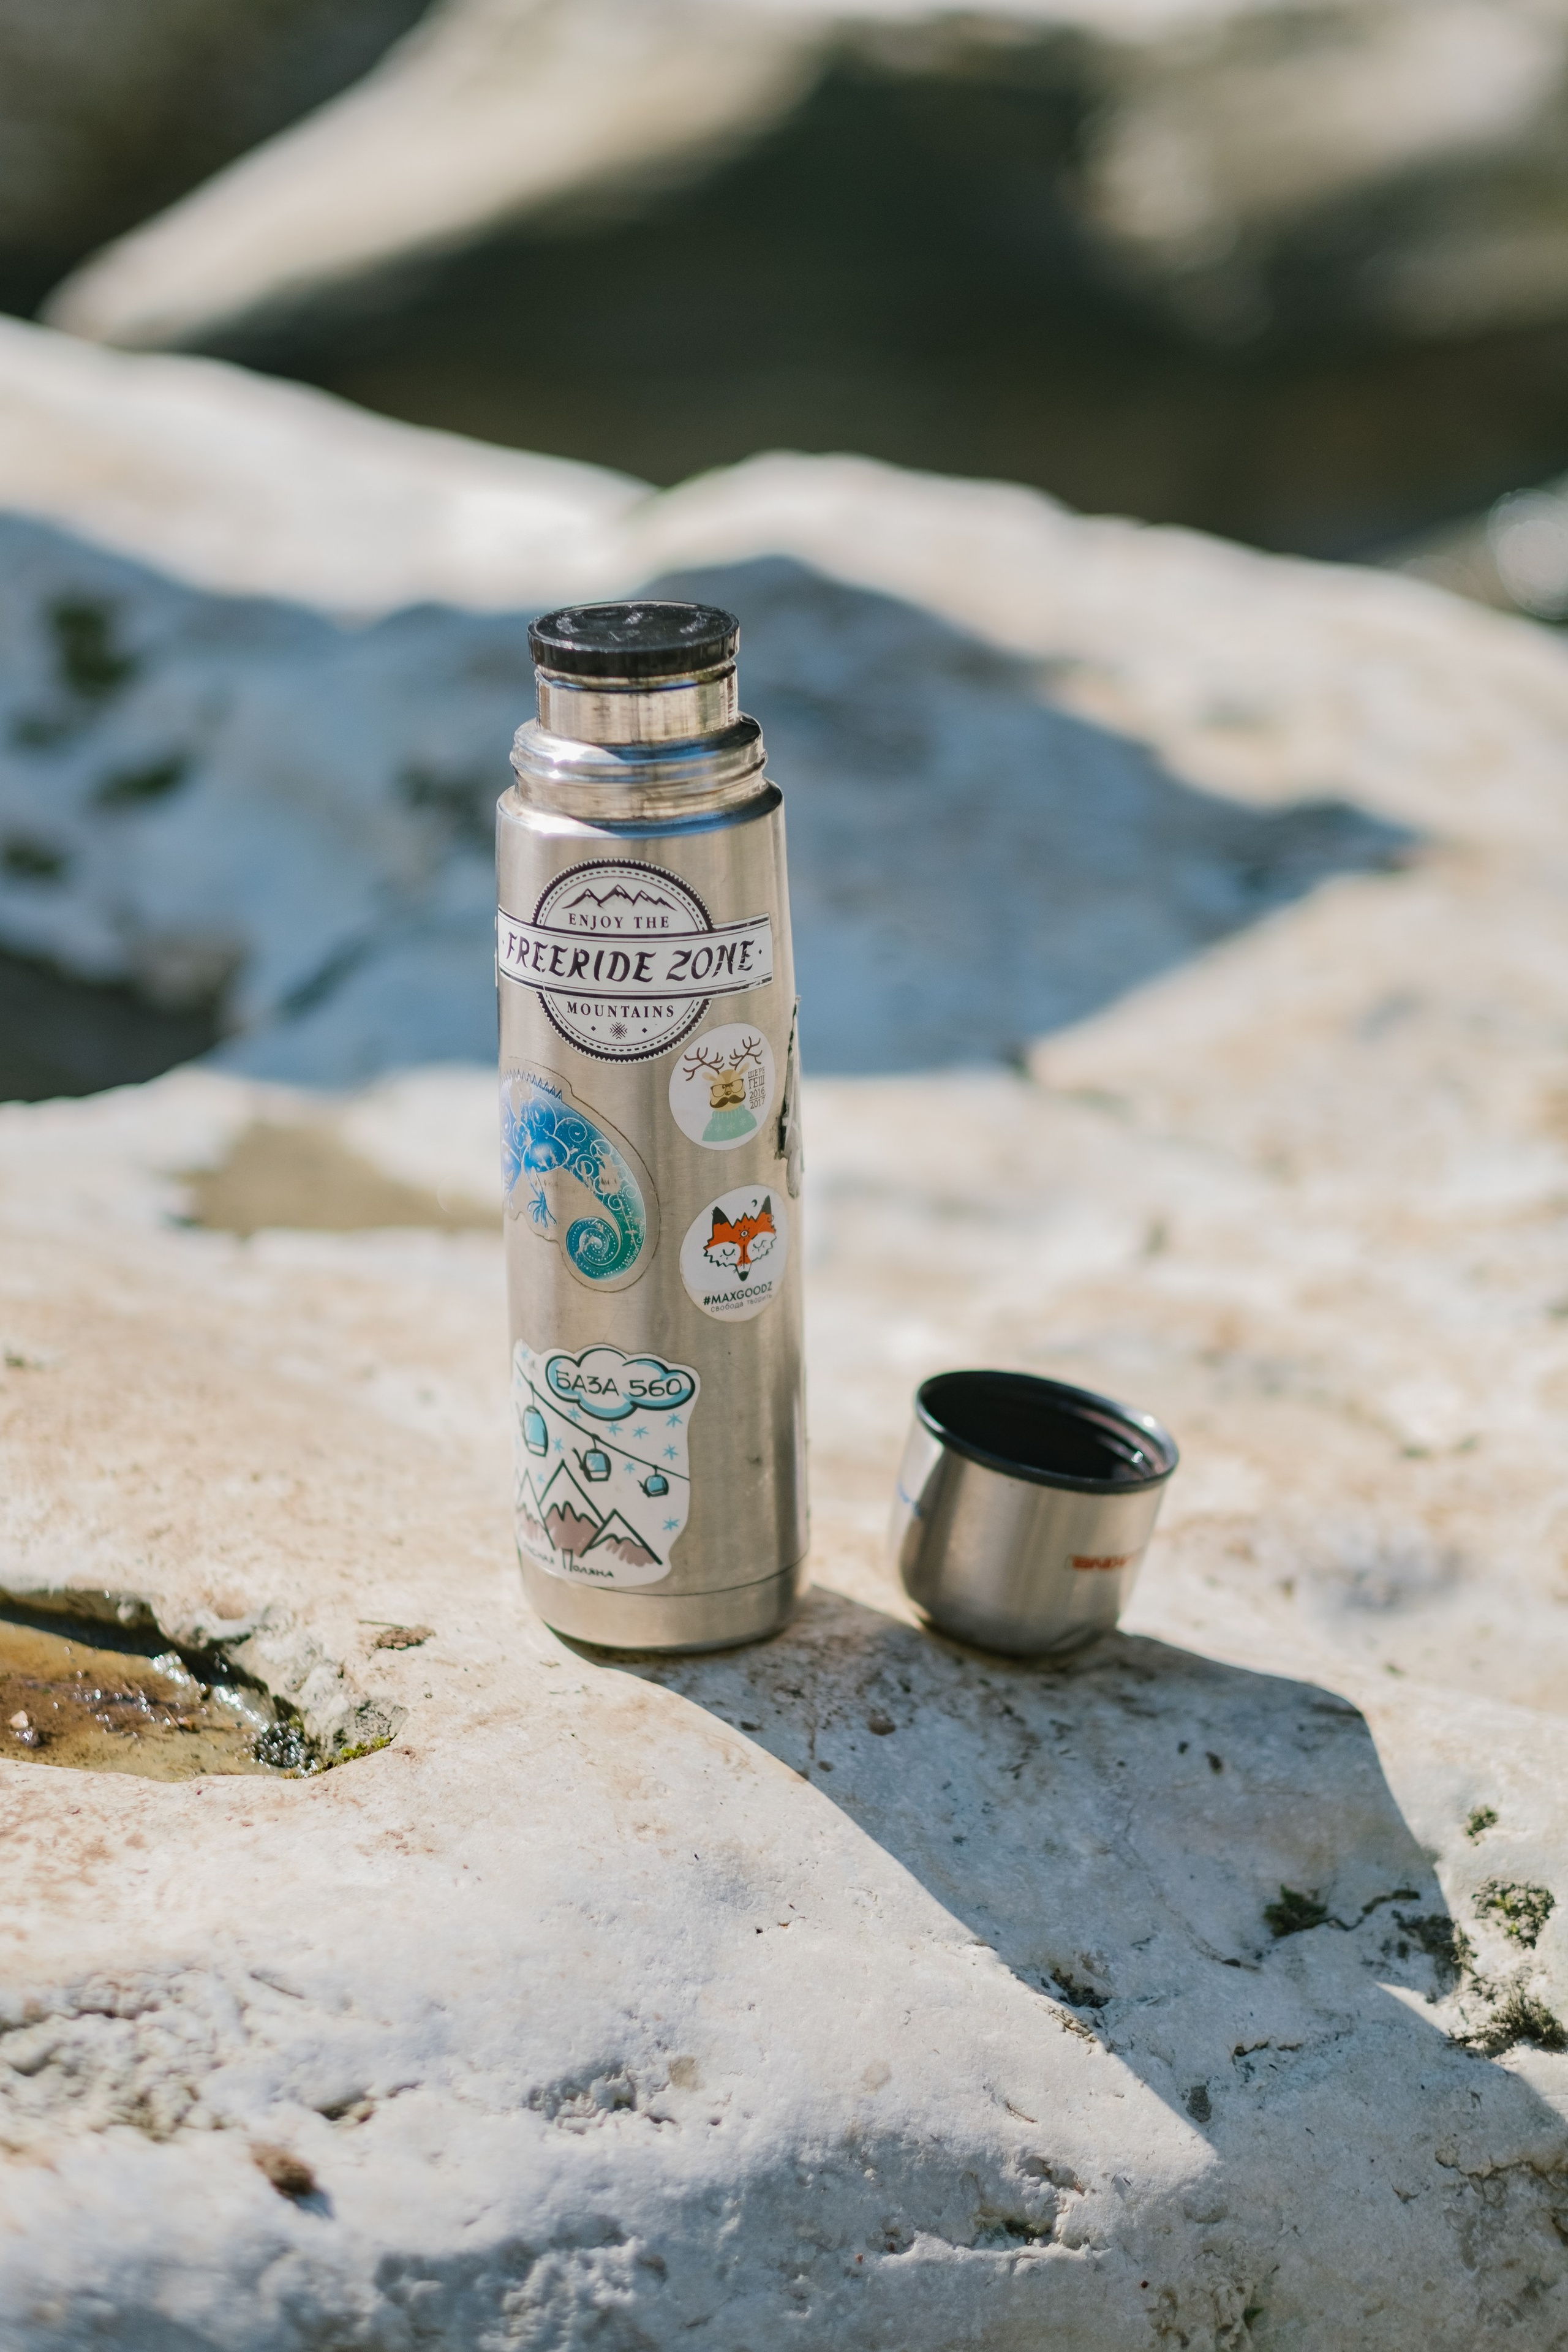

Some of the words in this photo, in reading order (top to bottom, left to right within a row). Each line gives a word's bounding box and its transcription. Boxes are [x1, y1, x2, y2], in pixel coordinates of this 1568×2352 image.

[568, 913, 624, 930] ENJOY
[635, 916, 669, 929] THE
[506, 931, 657, 982] FREERIDE
[666, 939, 755, 981] ZONE
[567, 1000, 674, 1018] MOUNTAINS
[748, 1066, 765, 1079] ШЕРЕ
[748, 1074, 765, 1090] ГЕШ
[749, 1087, 765, 1099] 2016
[750, 1096, 766, 1110] 2017
[703, 1281, 772, 1305] #MAXGOODZ
[556, 1370, 619, 1396] БАЗА
[628, 1378, 682, 1397] 560
